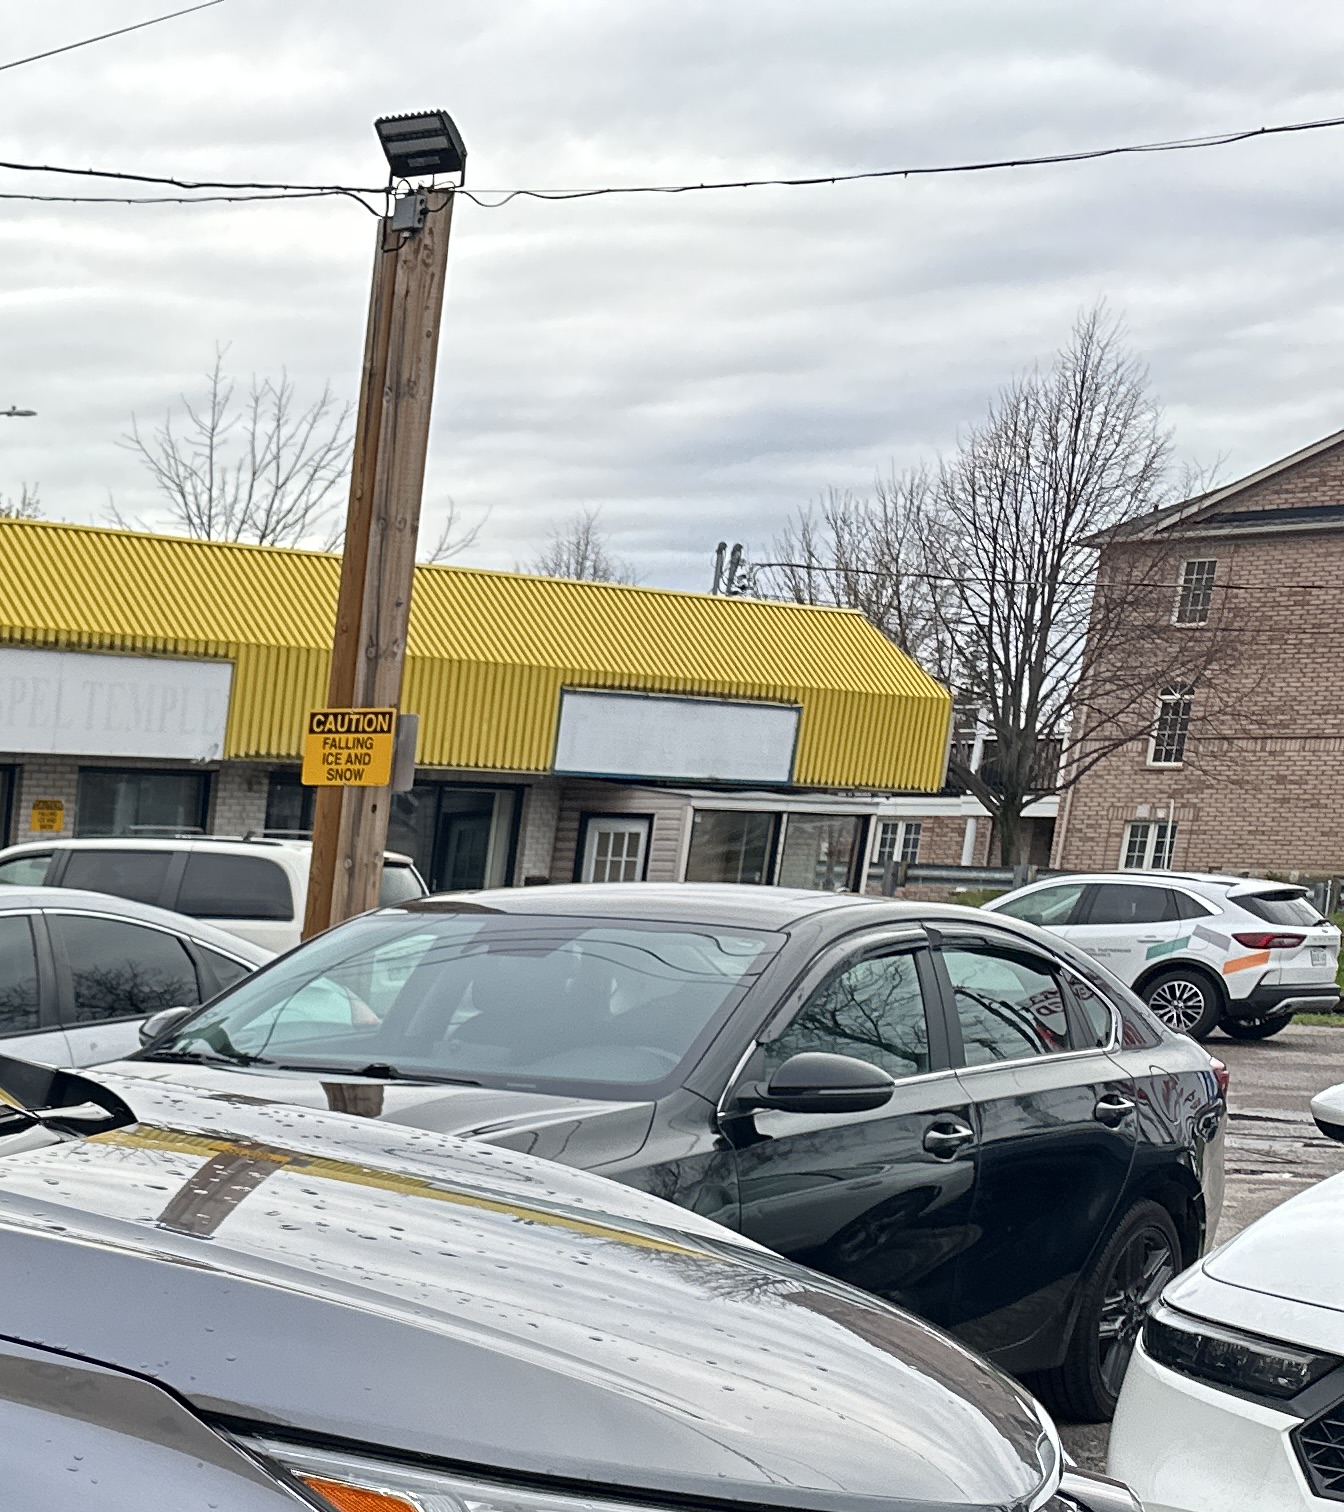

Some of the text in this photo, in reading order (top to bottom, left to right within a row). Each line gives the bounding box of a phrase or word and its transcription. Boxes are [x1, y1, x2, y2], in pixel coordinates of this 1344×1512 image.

[312, 713, 390, 733] CAUTION
[322, 736, 374, 751] FALLING
[322, 752, 372, 766] ICE AND
[326, 767, 365, 782] SNOW
